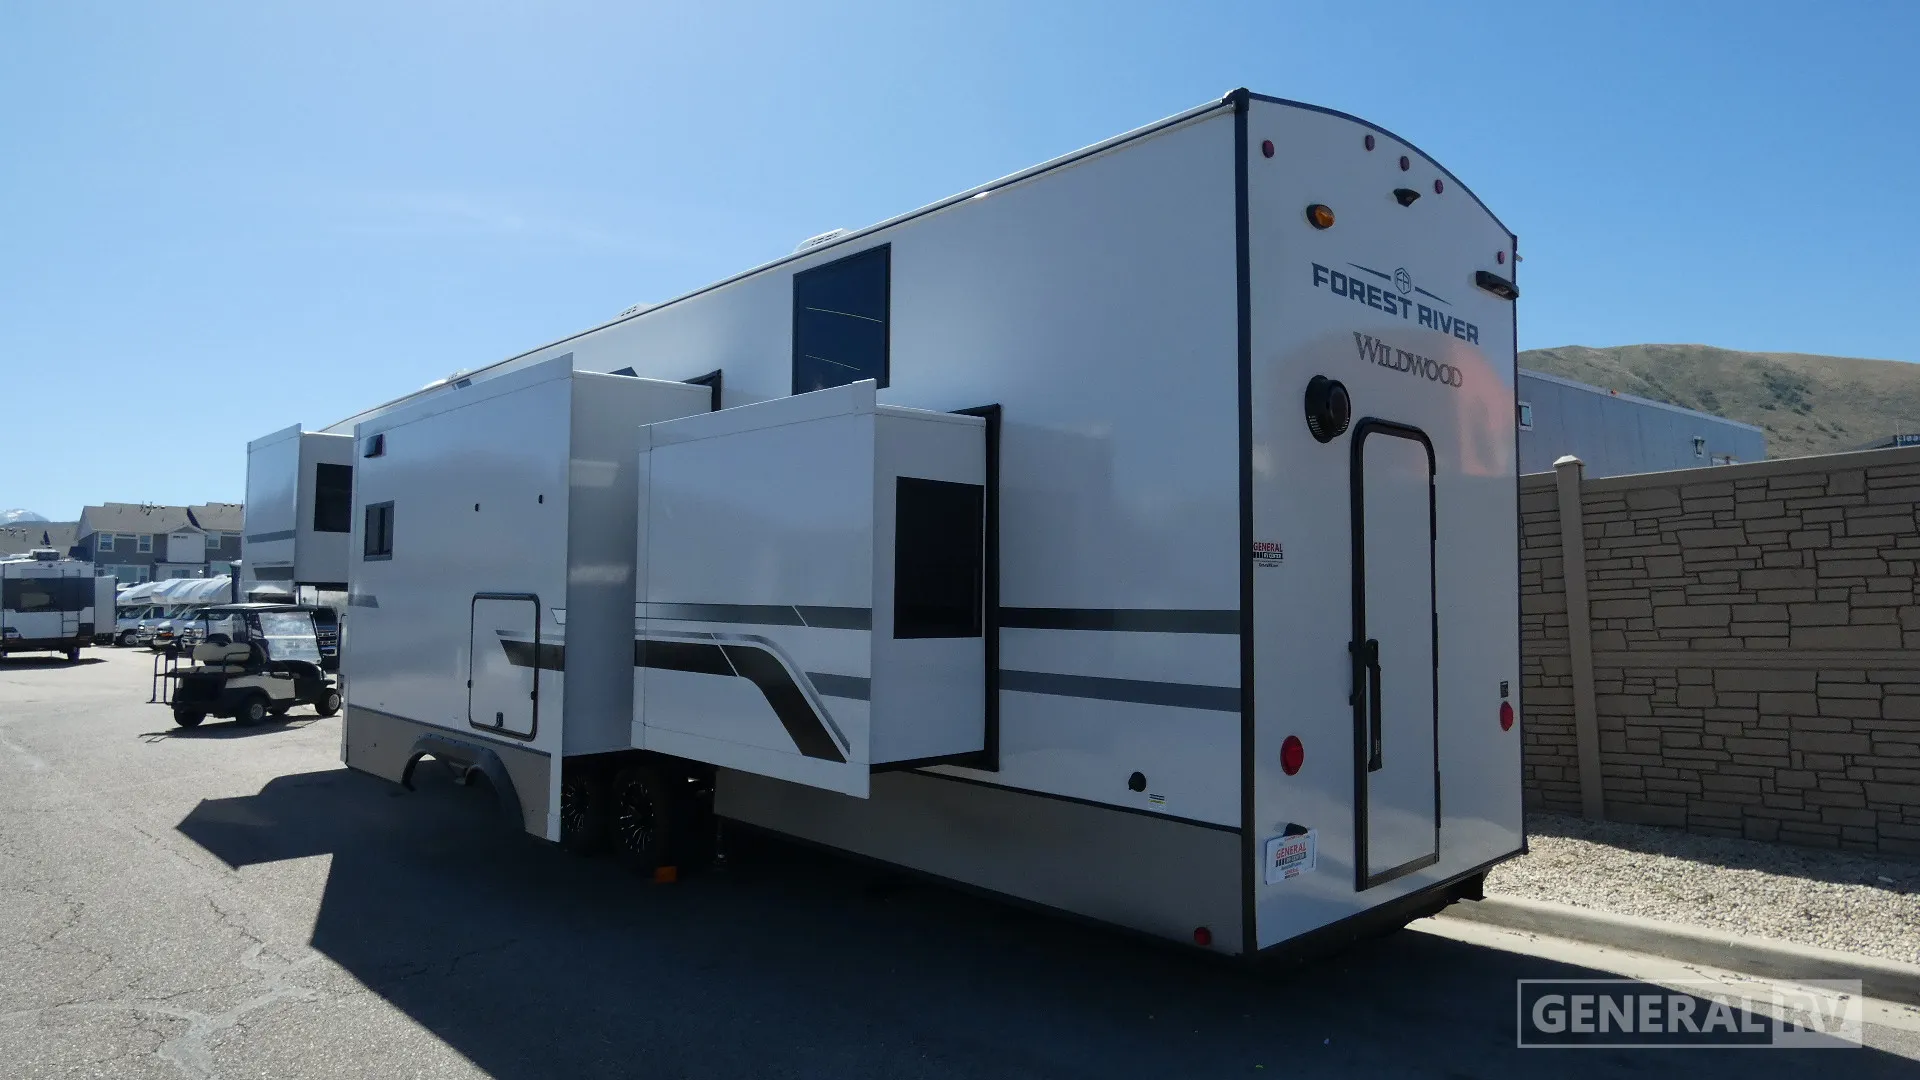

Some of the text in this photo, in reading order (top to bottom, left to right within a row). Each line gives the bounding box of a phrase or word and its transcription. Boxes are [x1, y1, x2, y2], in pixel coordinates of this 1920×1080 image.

[1311, 262, 1479, 345] FOREST RIVER
[1353, 331, 1463, 388] WILDWOOD
[1253, 542, 1283, 552] GENERAL
[1276, 842, 1307, 859] GENERAL
